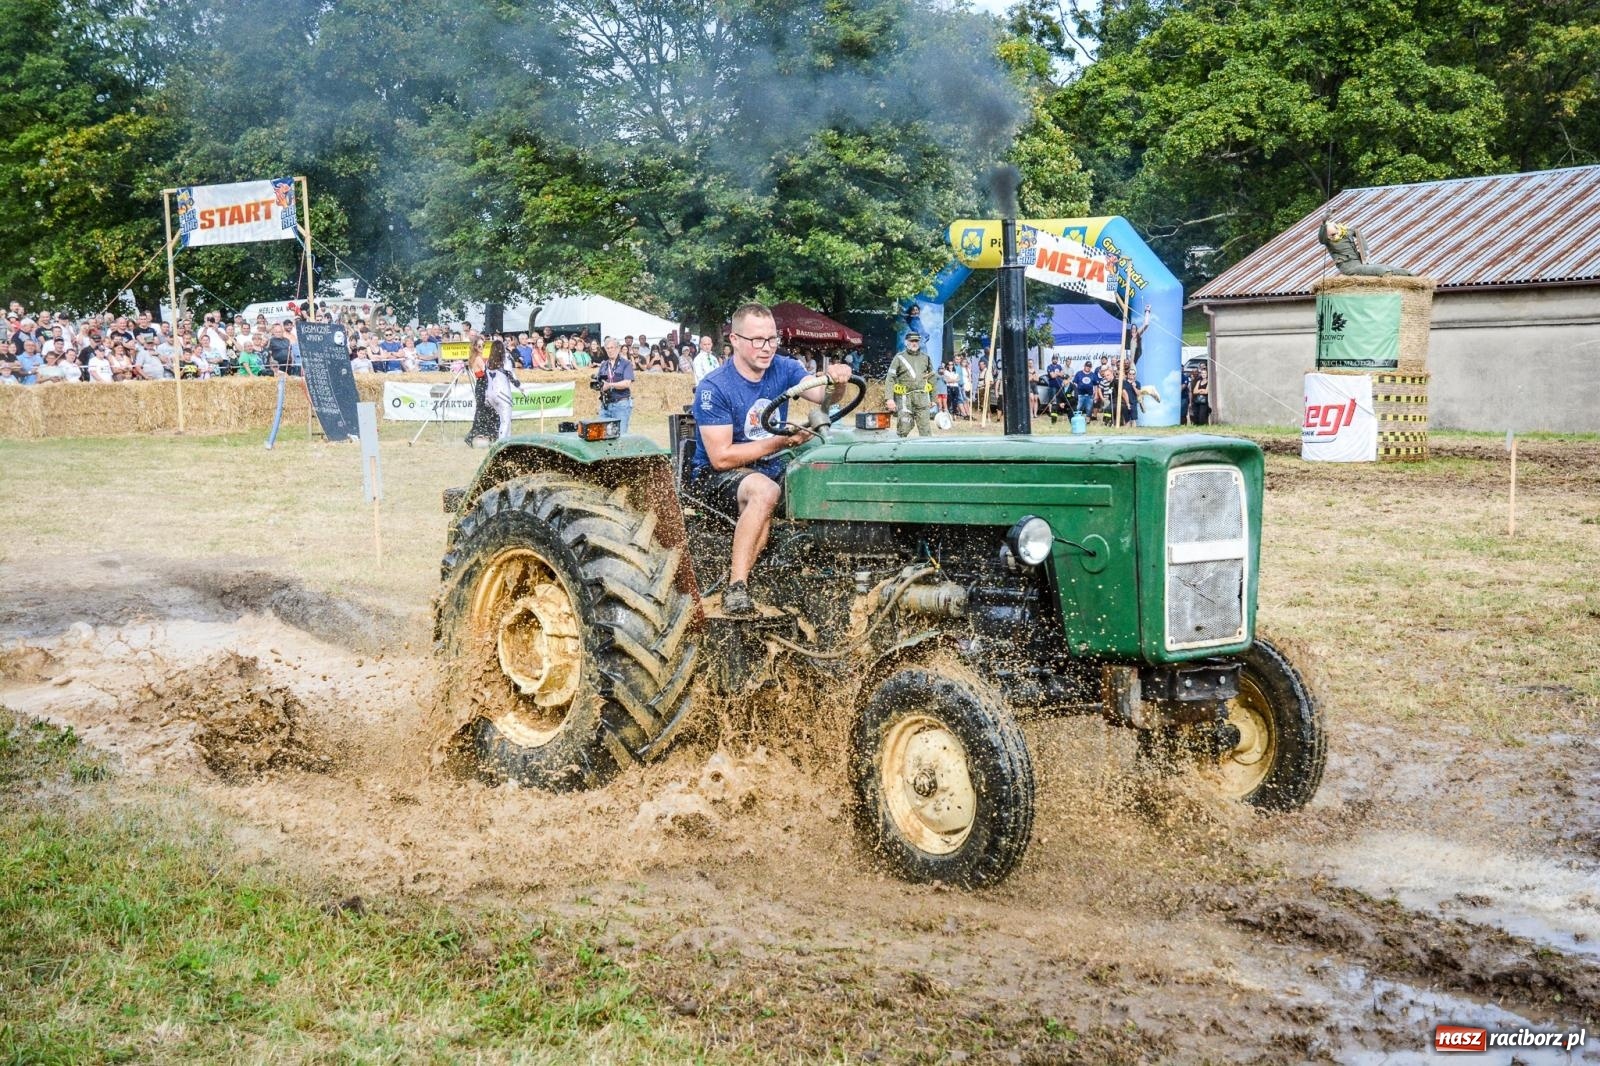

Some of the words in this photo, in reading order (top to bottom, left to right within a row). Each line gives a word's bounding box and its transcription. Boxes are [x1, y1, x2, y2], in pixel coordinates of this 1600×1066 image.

[199, 199, 275, 231] START
[1035, 247, 1106, 283] META
[1102, 237, 1127, 267] Gmia
[511, 395, 562, 406] LTERNATORY
